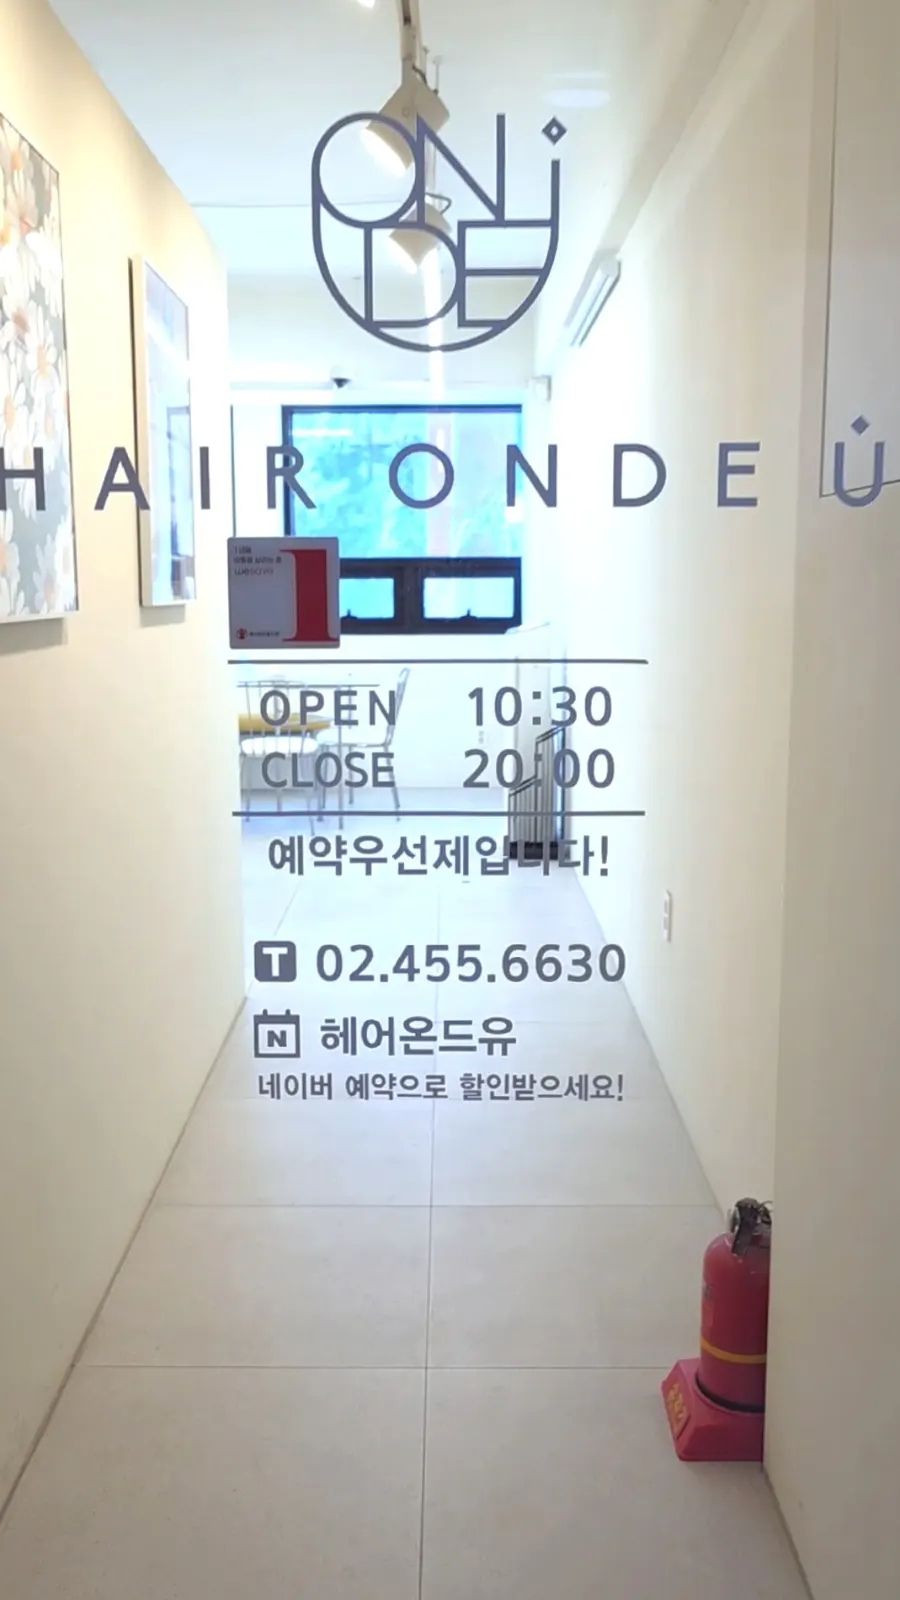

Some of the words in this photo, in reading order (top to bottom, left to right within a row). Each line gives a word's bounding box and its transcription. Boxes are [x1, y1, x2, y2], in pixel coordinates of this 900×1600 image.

[260, 689, 397, 727] OPEN
[468, 685, 613, 727] 10:30
[261, 751, 395, 788] CLOSE
[463, 748, 615, 788] 20:00
[268, 835, 609, 876] 예약우선제입니다!
[316, 944, 626, 983] 02.455.6630
[320, 1016, 517, 1056] 헤어온드유
[258, 1072, 333, 1100] 네이버
[345, 1072, 449, 1100] 예약으로
[459, 1073, 624, 1101] 할인받으세요!
